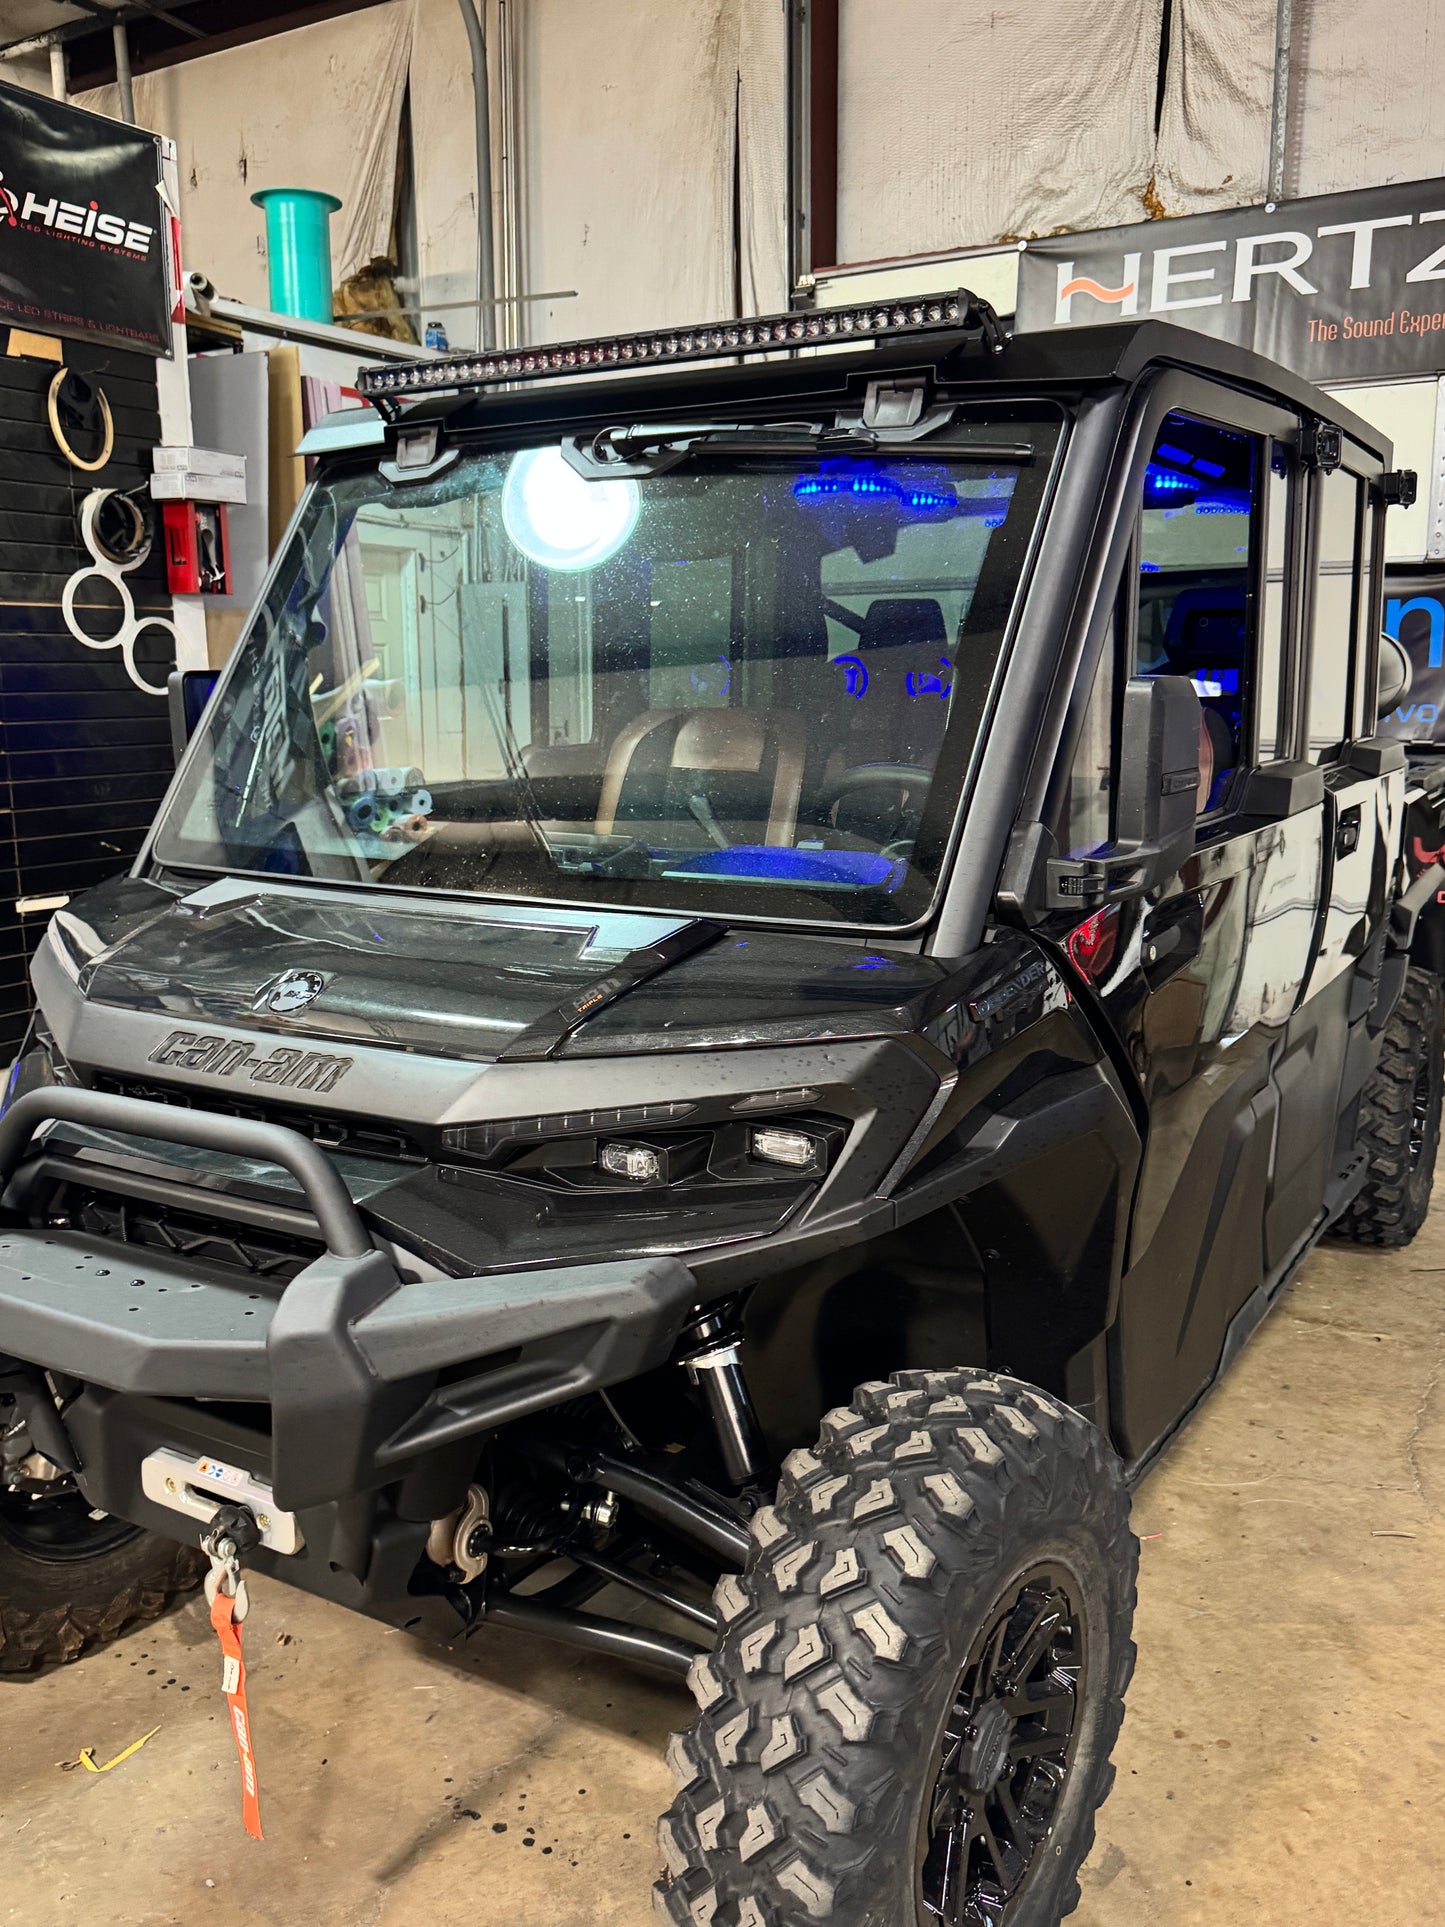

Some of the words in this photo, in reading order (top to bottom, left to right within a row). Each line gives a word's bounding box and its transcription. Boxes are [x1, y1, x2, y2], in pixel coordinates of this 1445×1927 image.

[20, 223, 41, 233] LED
[45, 230, 96, 248] LIGHTING
[100, 244, 147, 262] SYSTEMS
[1308, 319, 1338, 342] The
[1343, 311, 1395, 339] Sound
[576, 993, 604, 1013] TRIPLE
[148, 1031, 353, 1093] can-am
[233, 1705, 255, 1797] can-am
